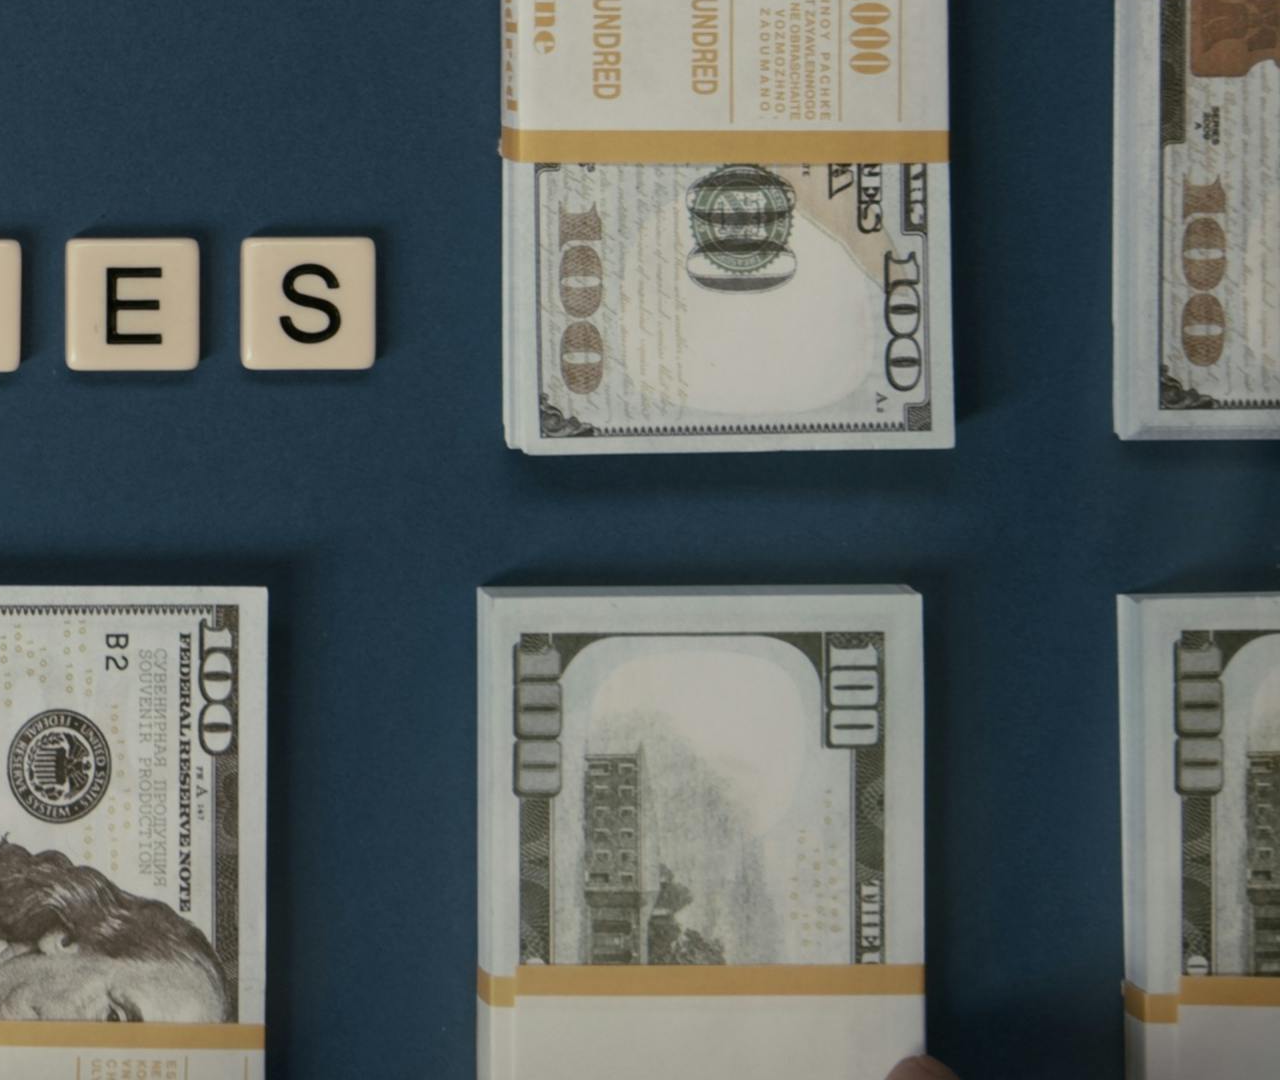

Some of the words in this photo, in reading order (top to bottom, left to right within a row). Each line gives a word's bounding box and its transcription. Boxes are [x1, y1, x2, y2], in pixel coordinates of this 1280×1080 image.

[686, 163, 797, 293] 00
[1179, 172, 1227, 368] 100
[557, 200, 604, 395] 100
[884, 249, 924, 393] 100
[178, 632, 193, 737] FEDERAL
[197, 618, 235, 758] 100
[177, 740, 192, 847] RESERVE
[178, 850, 192, 912] NOTE
